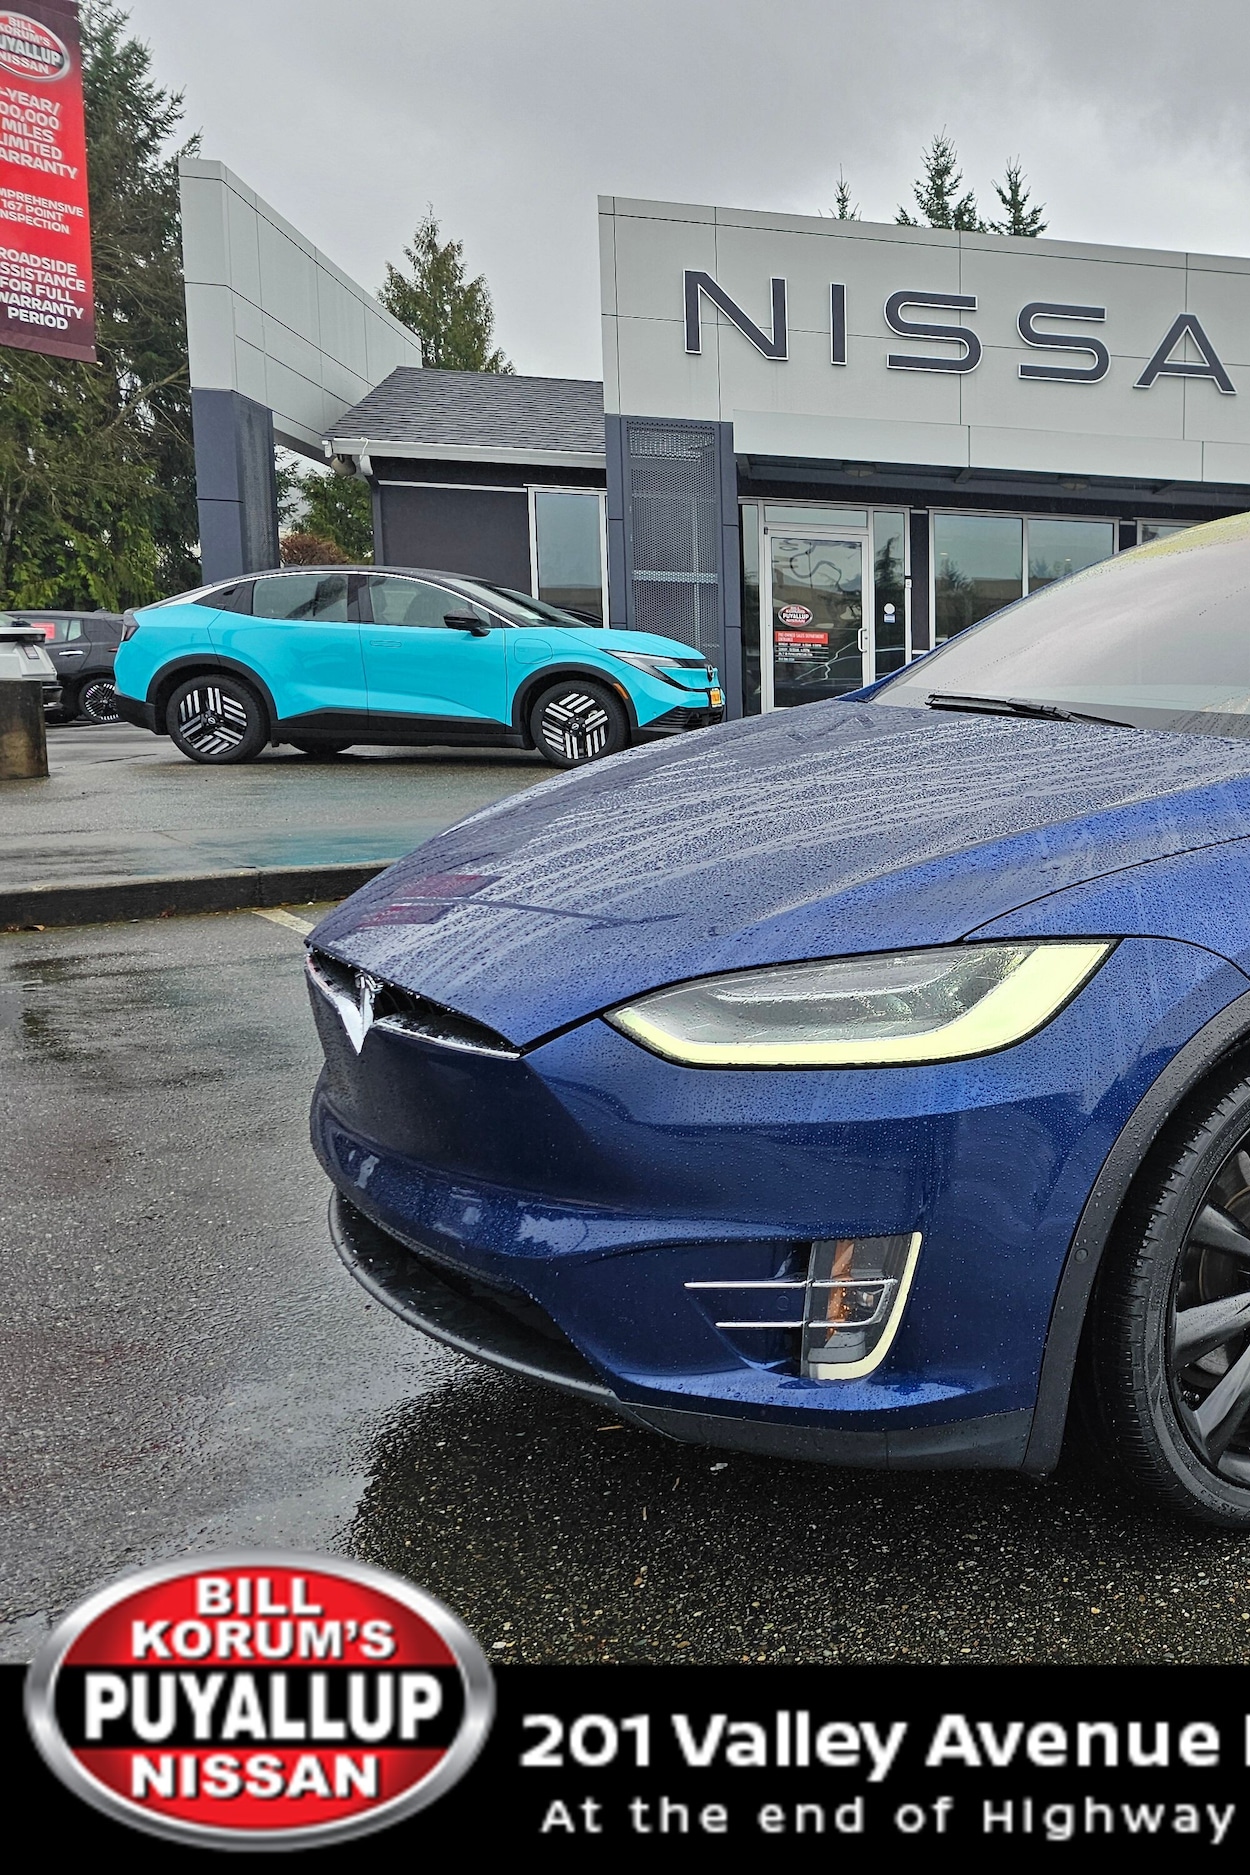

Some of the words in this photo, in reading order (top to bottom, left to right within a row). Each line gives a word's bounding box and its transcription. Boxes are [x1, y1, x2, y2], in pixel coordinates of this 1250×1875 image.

[8, 16, 35, 33] BILL
[0, 33, 61, 65] UYALLUP
[0, 87, 61, 116] -YEAR/
[0, 101, 60, 130] 00,000
[2, 118, 55, 143] MILES
[0, 147, 78, 179] ARRANTY
[0, 188, 84, 217] MPREHENSIVE
[2, 199, 23, 213] 167
[25, 205, 64, 222] POINT
[0, 208, 70, 235] NSPECTION
[0, 261, 86, 292] SSISTANCE
[0, 275, 33, 295] FOR
[35, 283, 75, 304] FULL
[8, 306, 69, 330] PERIOD
